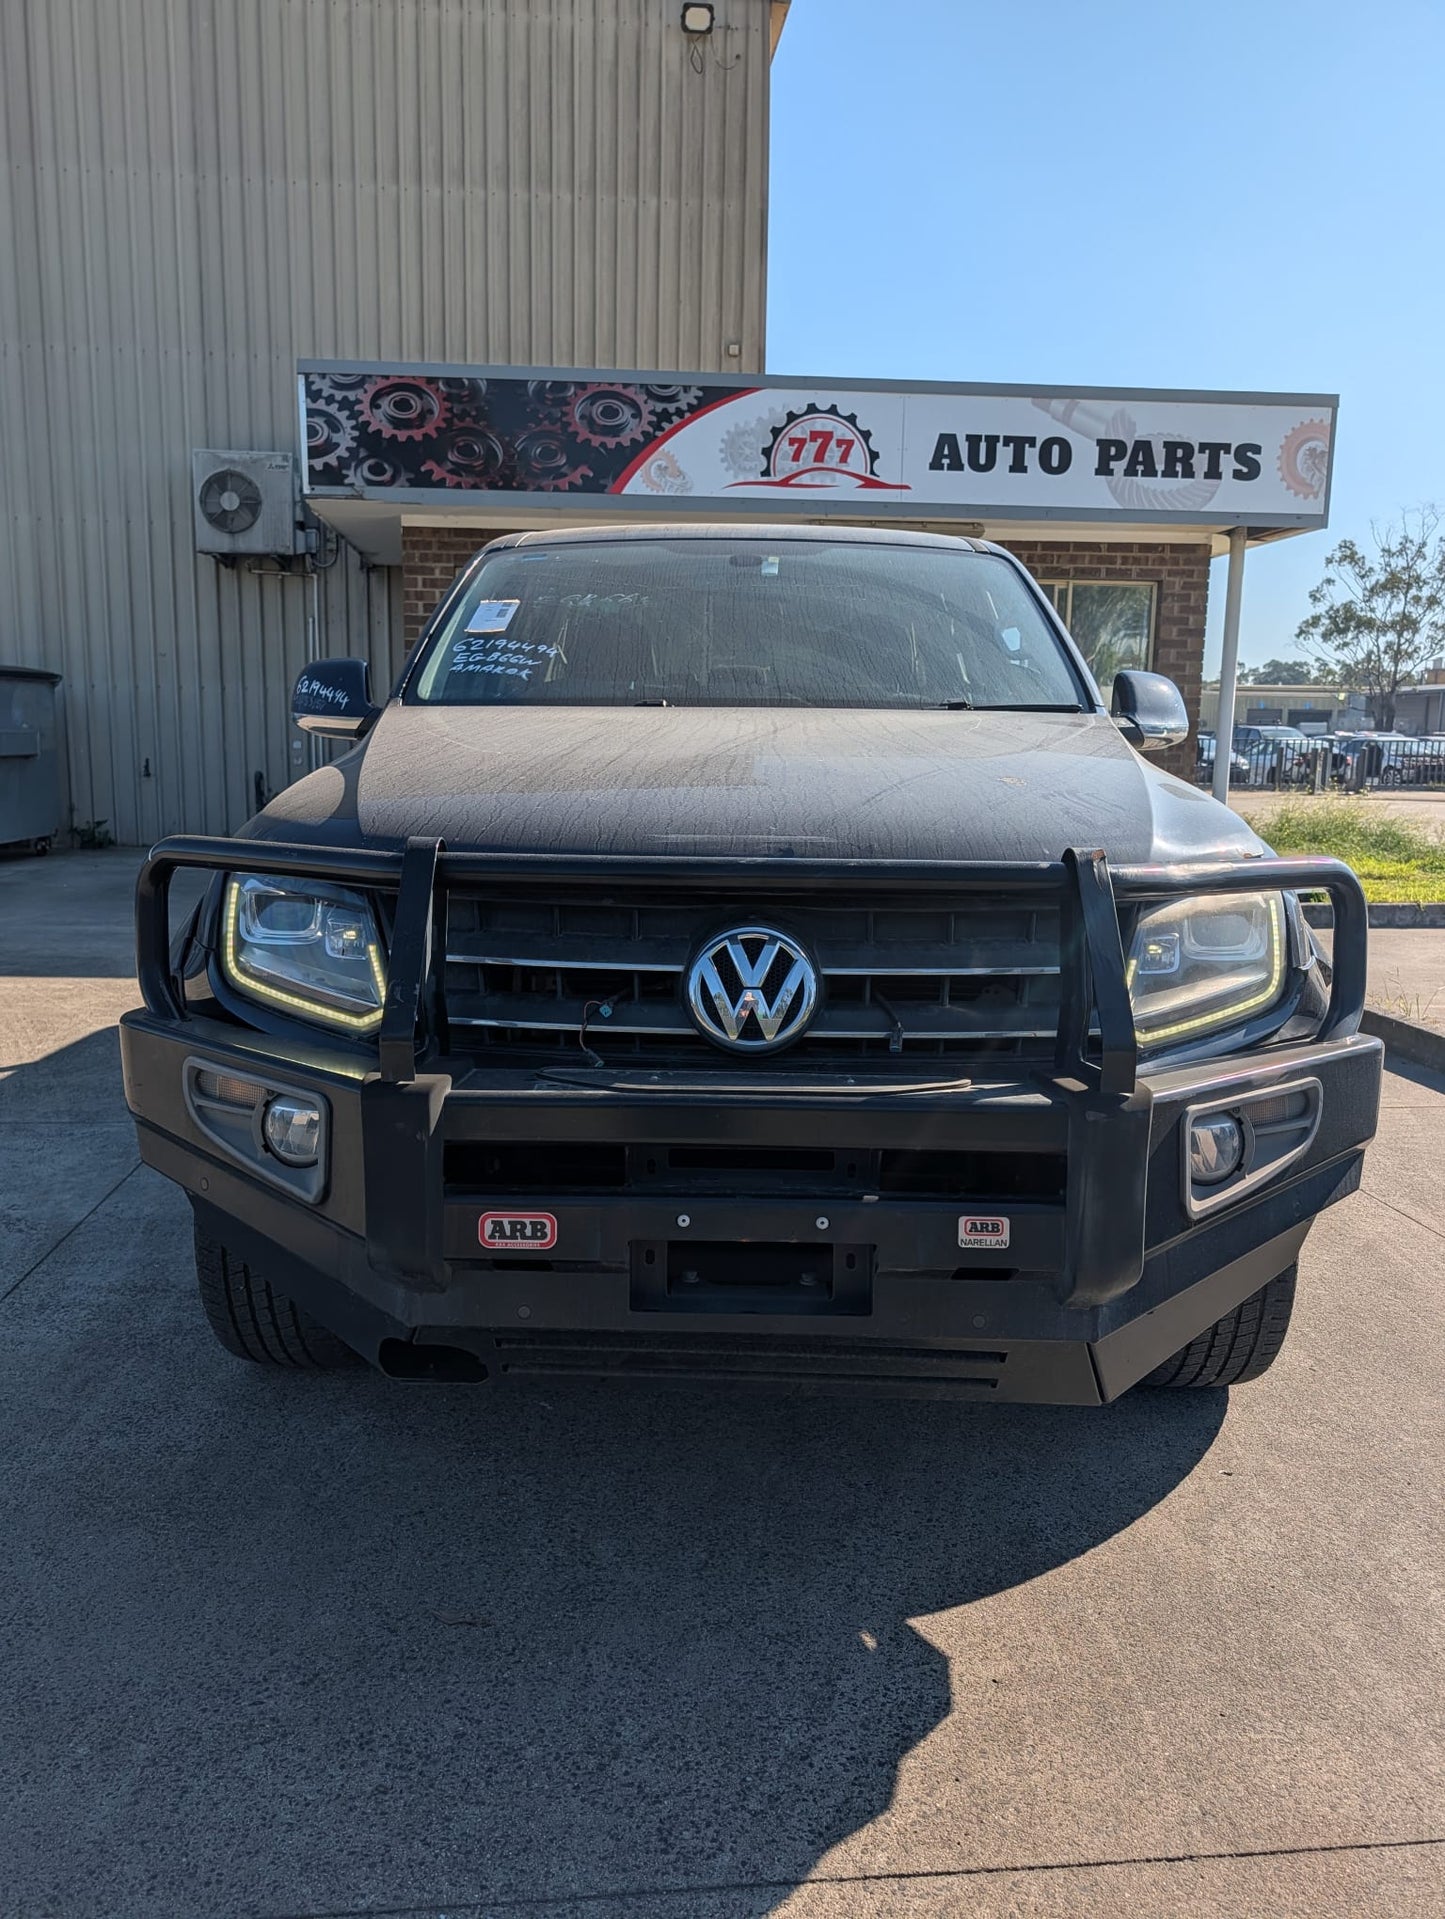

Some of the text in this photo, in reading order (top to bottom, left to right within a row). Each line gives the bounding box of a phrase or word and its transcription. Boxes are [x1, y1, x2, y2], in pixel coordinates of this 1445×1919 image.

[788, 430, 855, 464] 777
[928, 433, 1262, 481] AUTO PARTS
[452, 638, 559, 658] 62194494
[487, 1220, 549, 1241] ARB
[968, 1222, 1001, 1233] ARB
[960, 1238, 1008, 1247] NARELLAN
